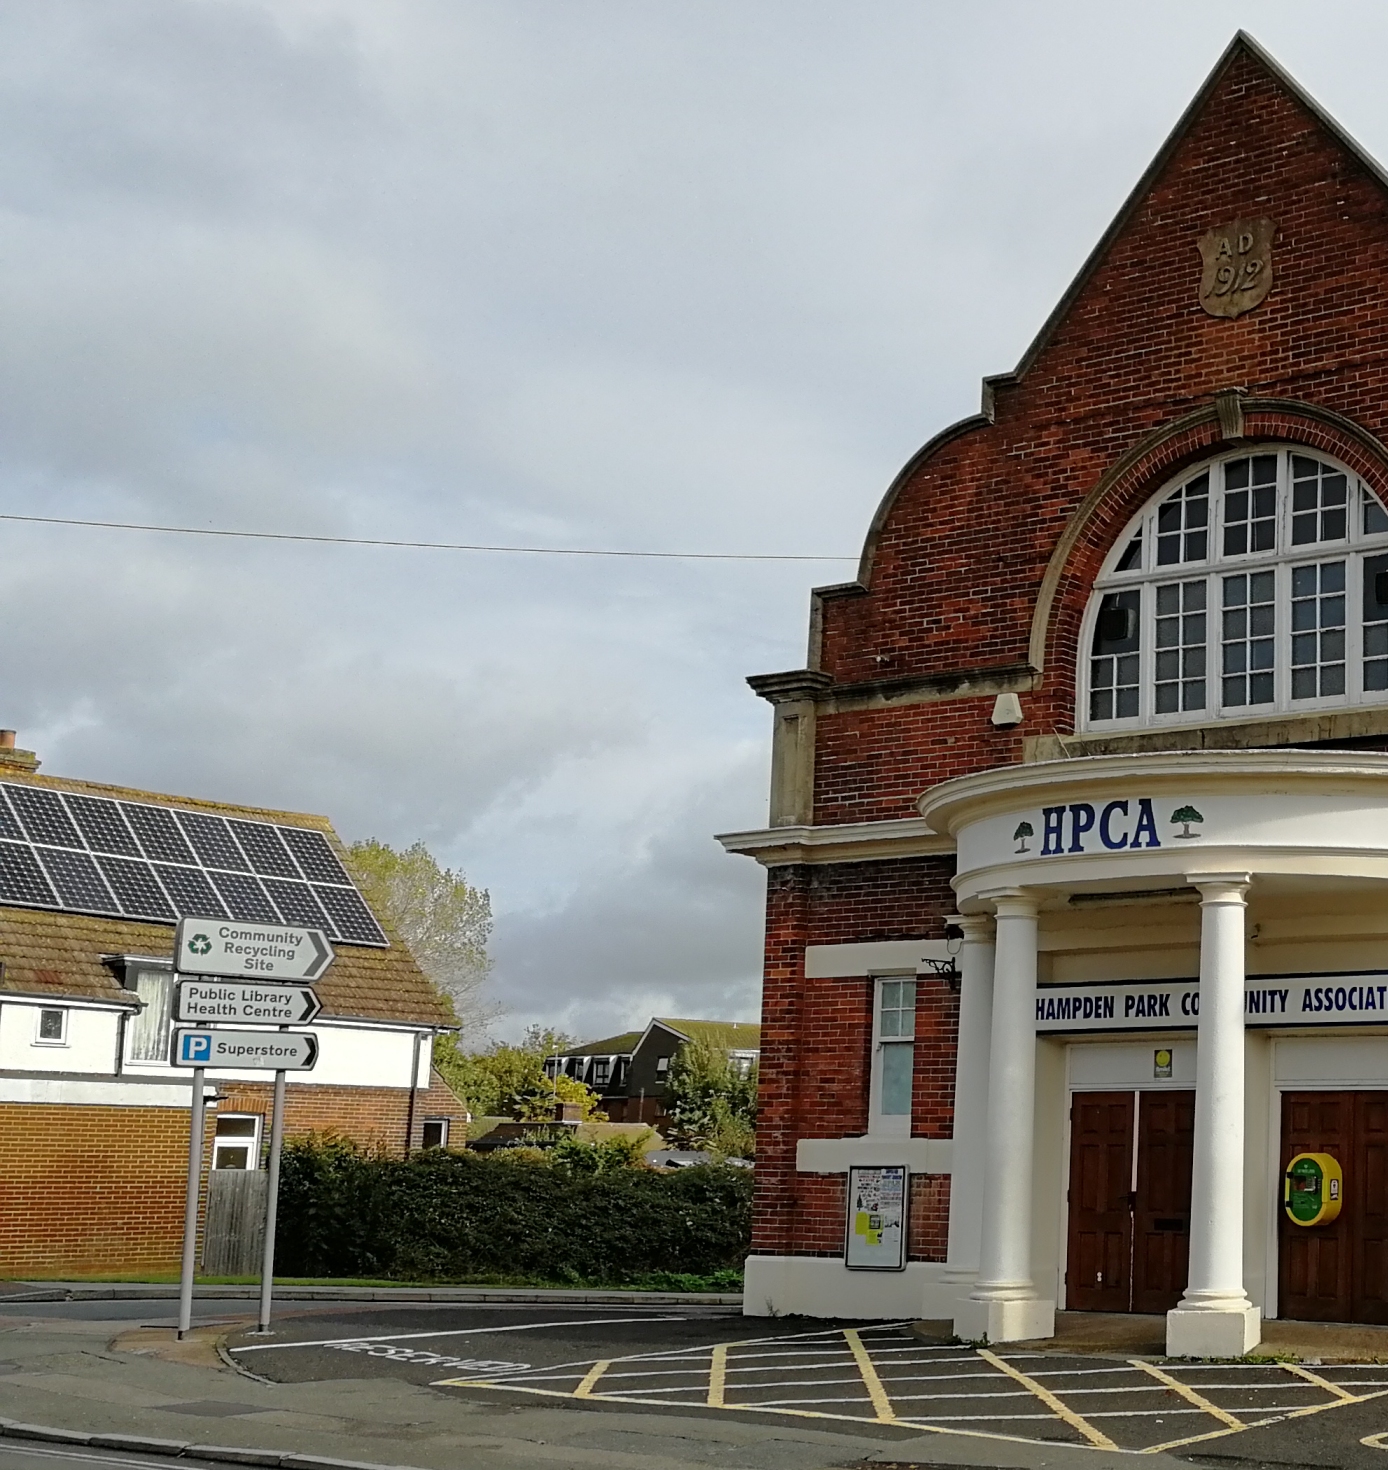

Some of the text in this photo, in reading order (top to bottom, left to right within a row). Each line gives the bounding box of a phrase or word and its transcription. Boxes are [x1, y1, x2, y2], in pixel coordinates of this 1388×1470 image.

[1040, 798, 1161, 856] HPCA
[219, 926, 303, 947] Community
[224, 942, 296, 960] Recycling
[243, 958, 274, 971] Site
[188, 987, 292, 1005] Public Library
[1035, 995, 1115, 1021] HAMPDEN
[1124, 993, 1171, 1018] PARK
[1181, 988, 1290, 1016] CONITY
[187, 1002, 292, 1018] Health Centre
[188, 1037, 298, 1059] P Superstore
[323, 1342, 531, 1371] RESERVED
